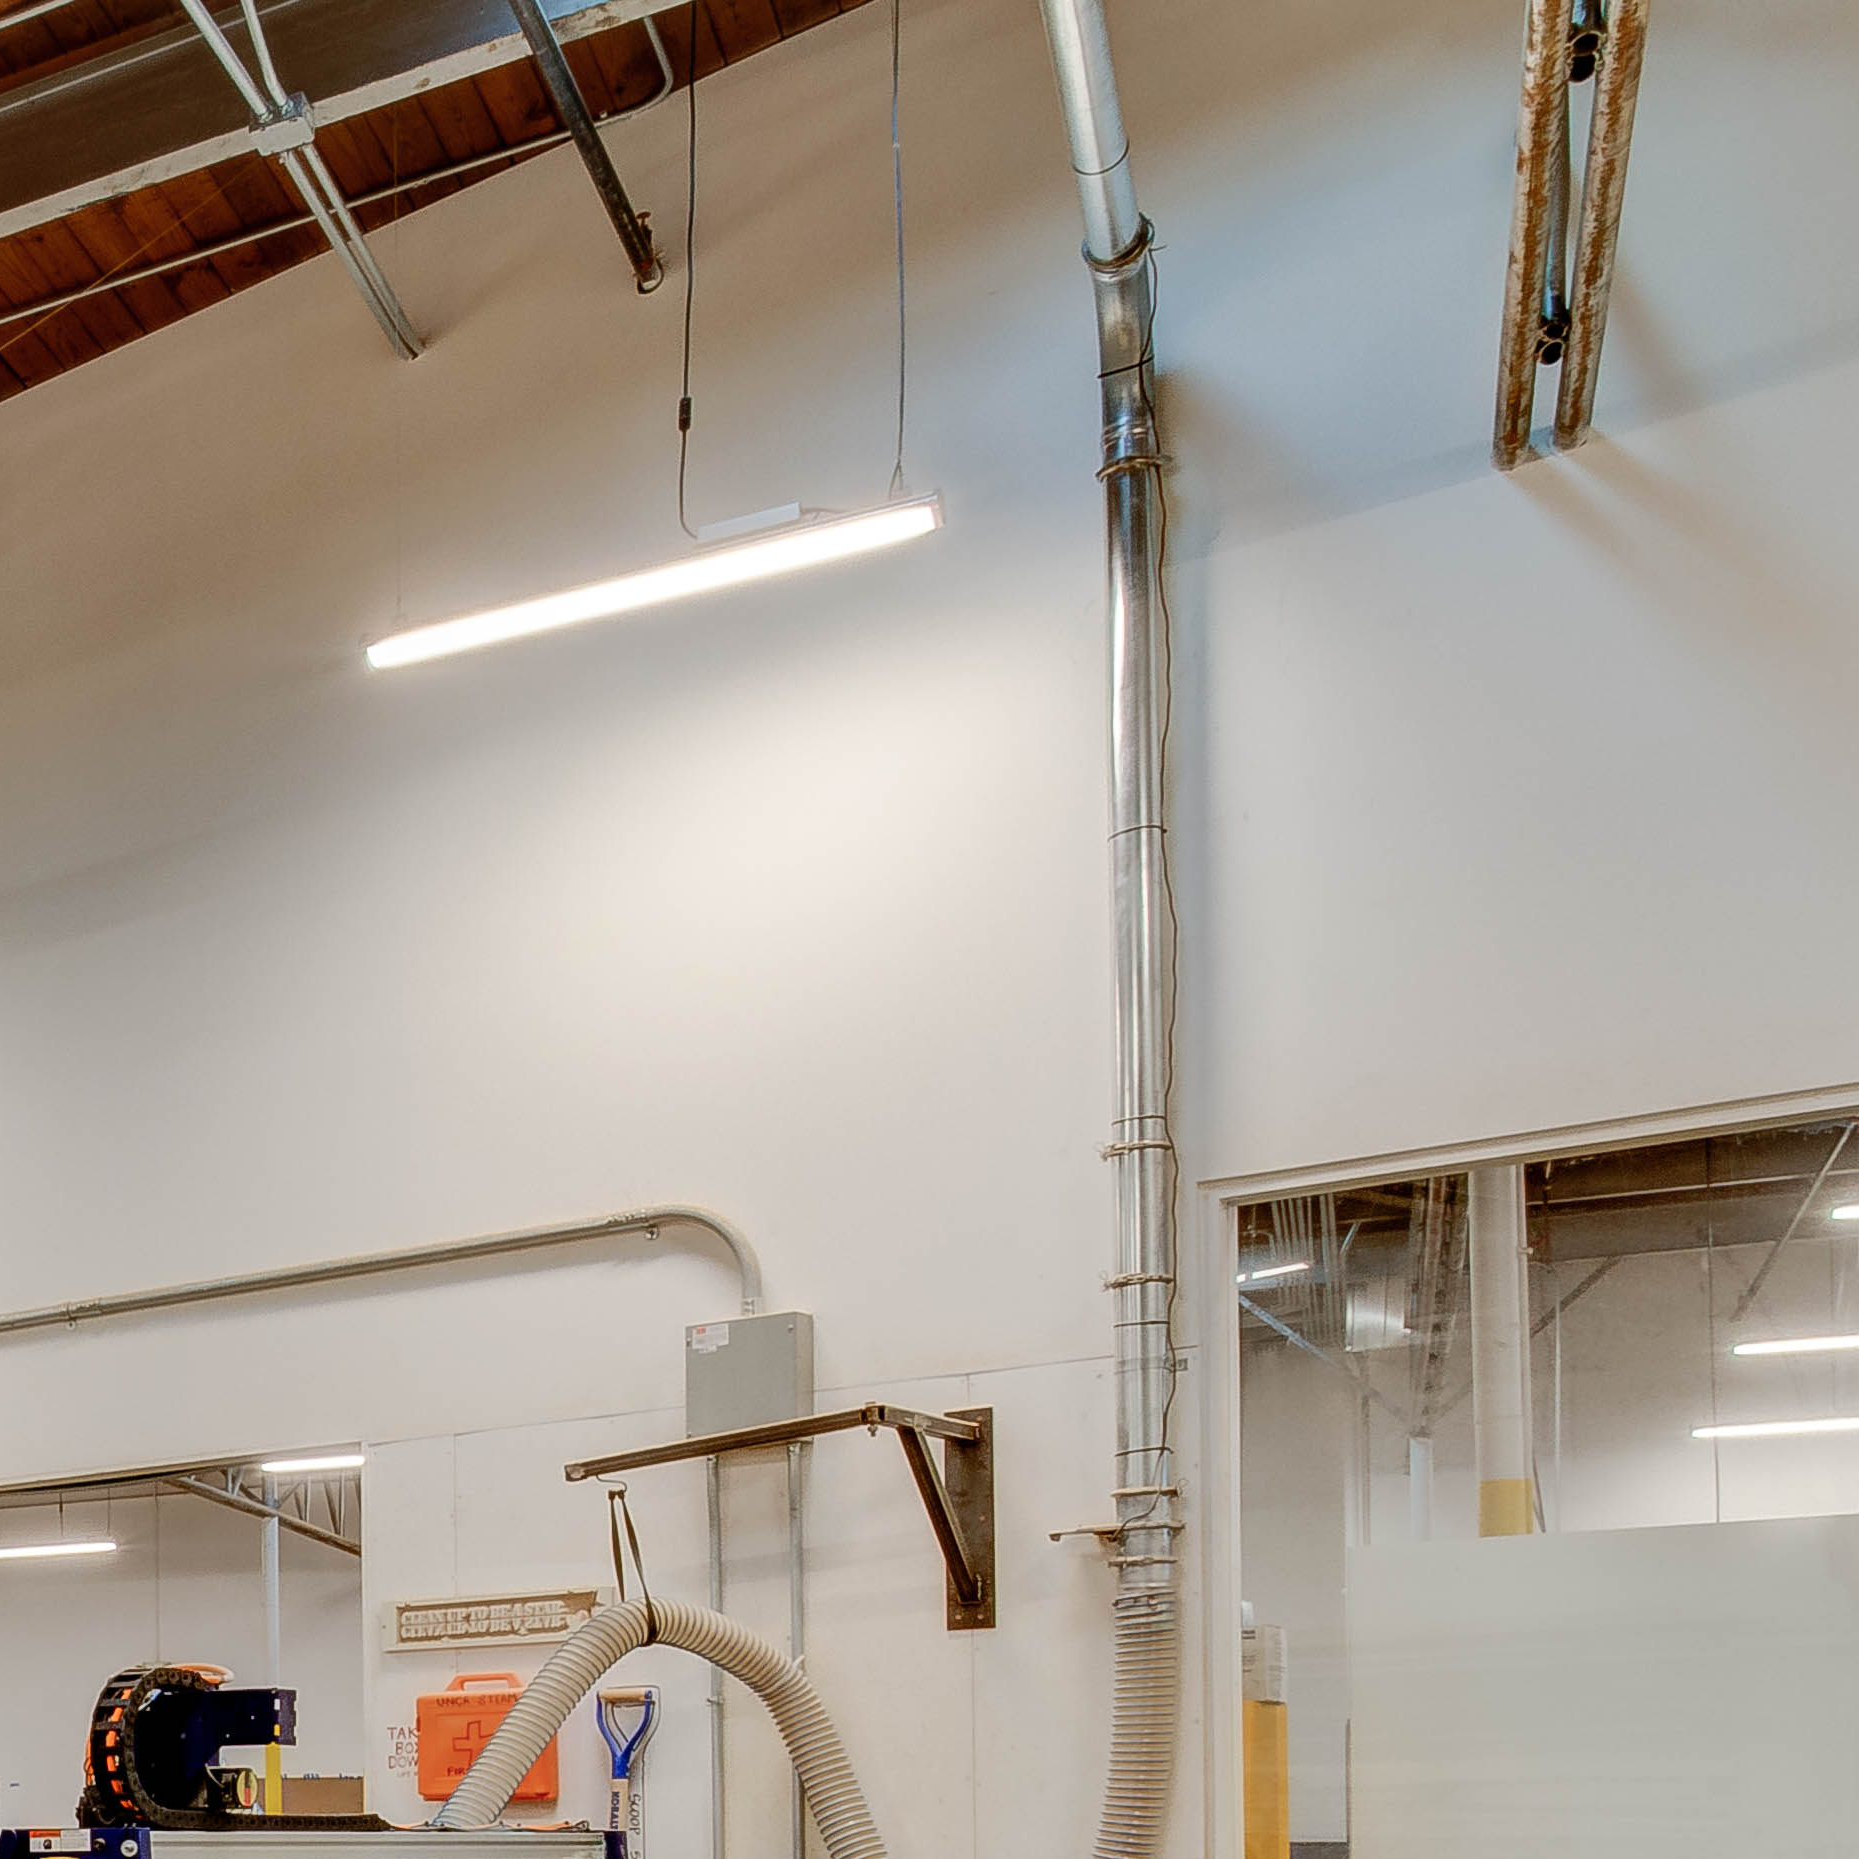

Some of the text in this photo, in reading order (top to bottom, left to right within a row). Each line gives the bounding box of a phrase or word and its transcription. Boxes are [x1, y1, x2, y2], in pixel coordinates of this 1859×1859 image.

[386, 1726, 418, 1740] TAK
[387, 1755, 419, 1769] DOW
[628, 1793, 641, 1836] SCOOP
